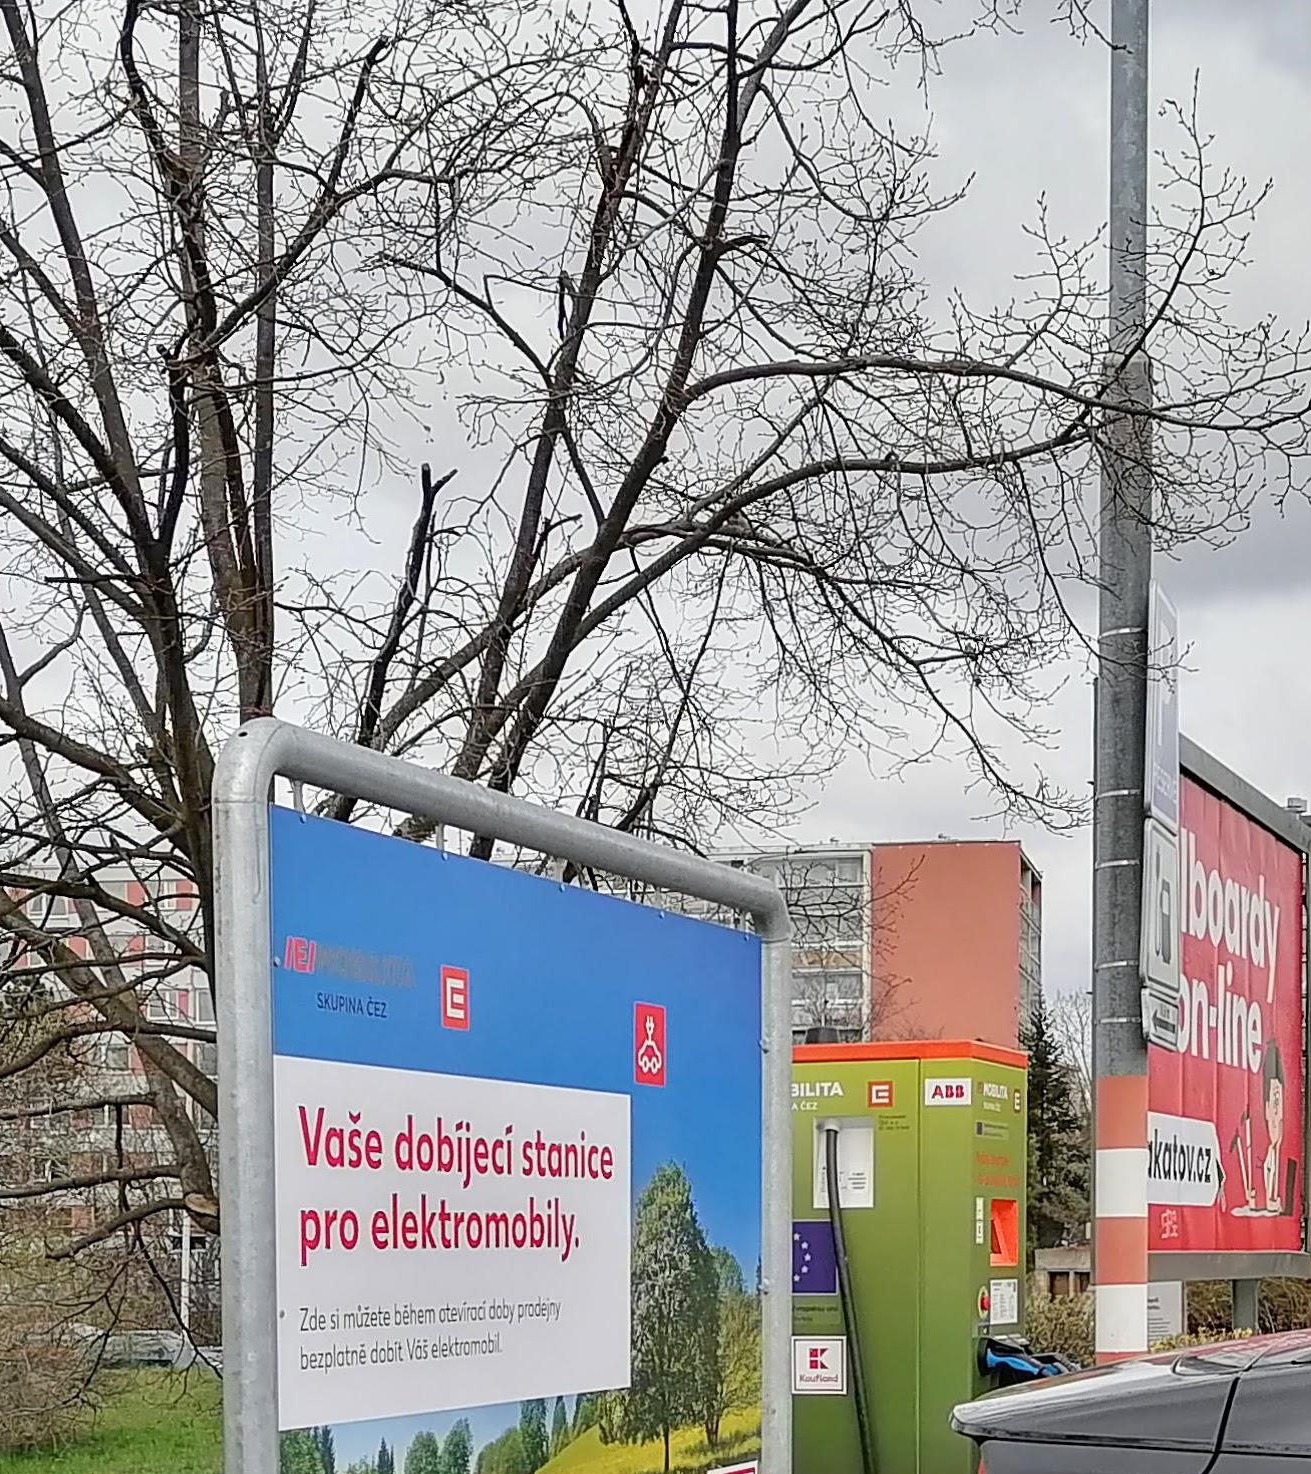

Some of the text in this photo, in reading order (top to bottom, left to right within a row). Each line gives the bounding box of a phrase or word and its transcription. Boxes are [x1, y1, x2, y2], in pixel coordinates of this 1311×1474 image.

[1180, 827, 1280, 1004] lboardy
[316, 992, 387, 1018] SKUPINA ČEZ
[800, 1101, 818, 1111] ČEZ
[932, 1085, 965, 1099] ABB
[298, 1105, 614, 1189] Vaše dobíjecí stanice
[300, 1193, 580, 1267] pro elektromobily.
[299, 1296, 562, 1332] Zde si můžete během otevírací doby prodejny
[300, 1332, 503, 1374] bezplatně dobít Váš elektromobil.
